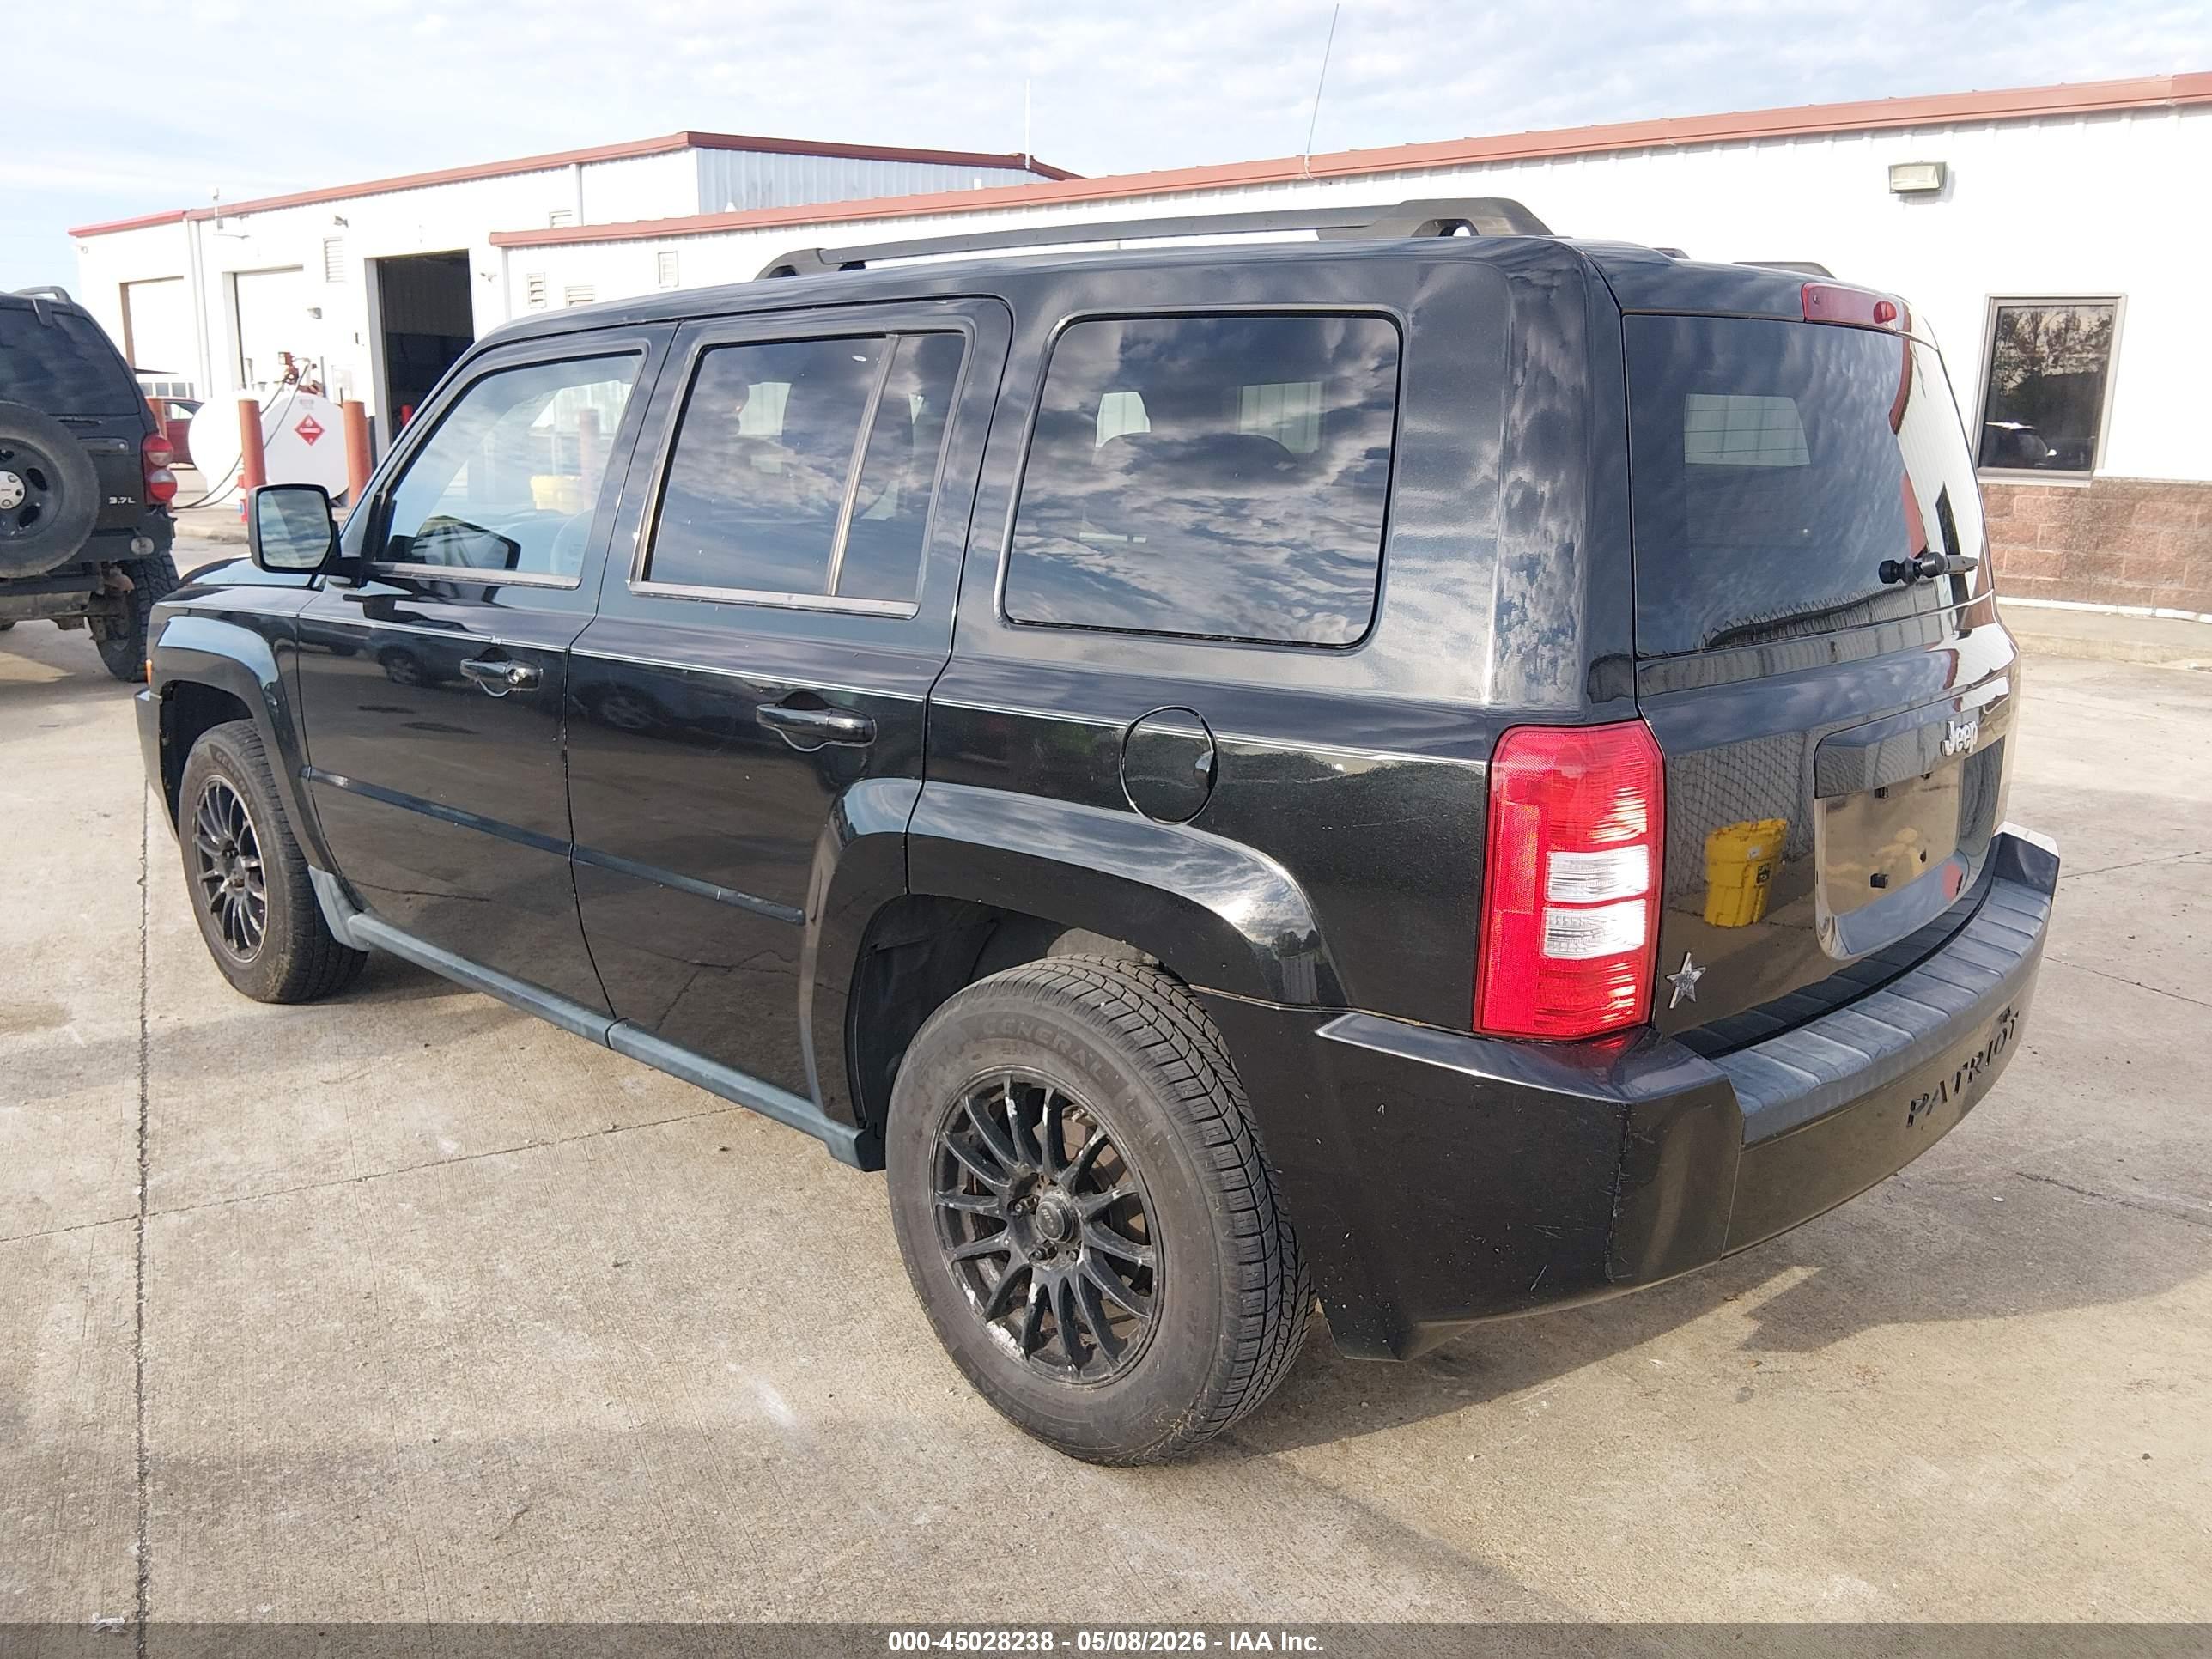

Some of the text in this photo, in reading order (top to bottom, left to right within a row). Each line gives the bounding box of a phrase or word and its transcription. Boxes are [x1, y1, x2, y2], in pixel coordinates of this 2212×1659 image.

[109, 496, 137, 505] 3.7L
[1940, 720, 1978, 757] Jeep
[981, 1015, 1106, 1081] GENERAL
[1905, 1009, 2020, 1128] PATRIOT
